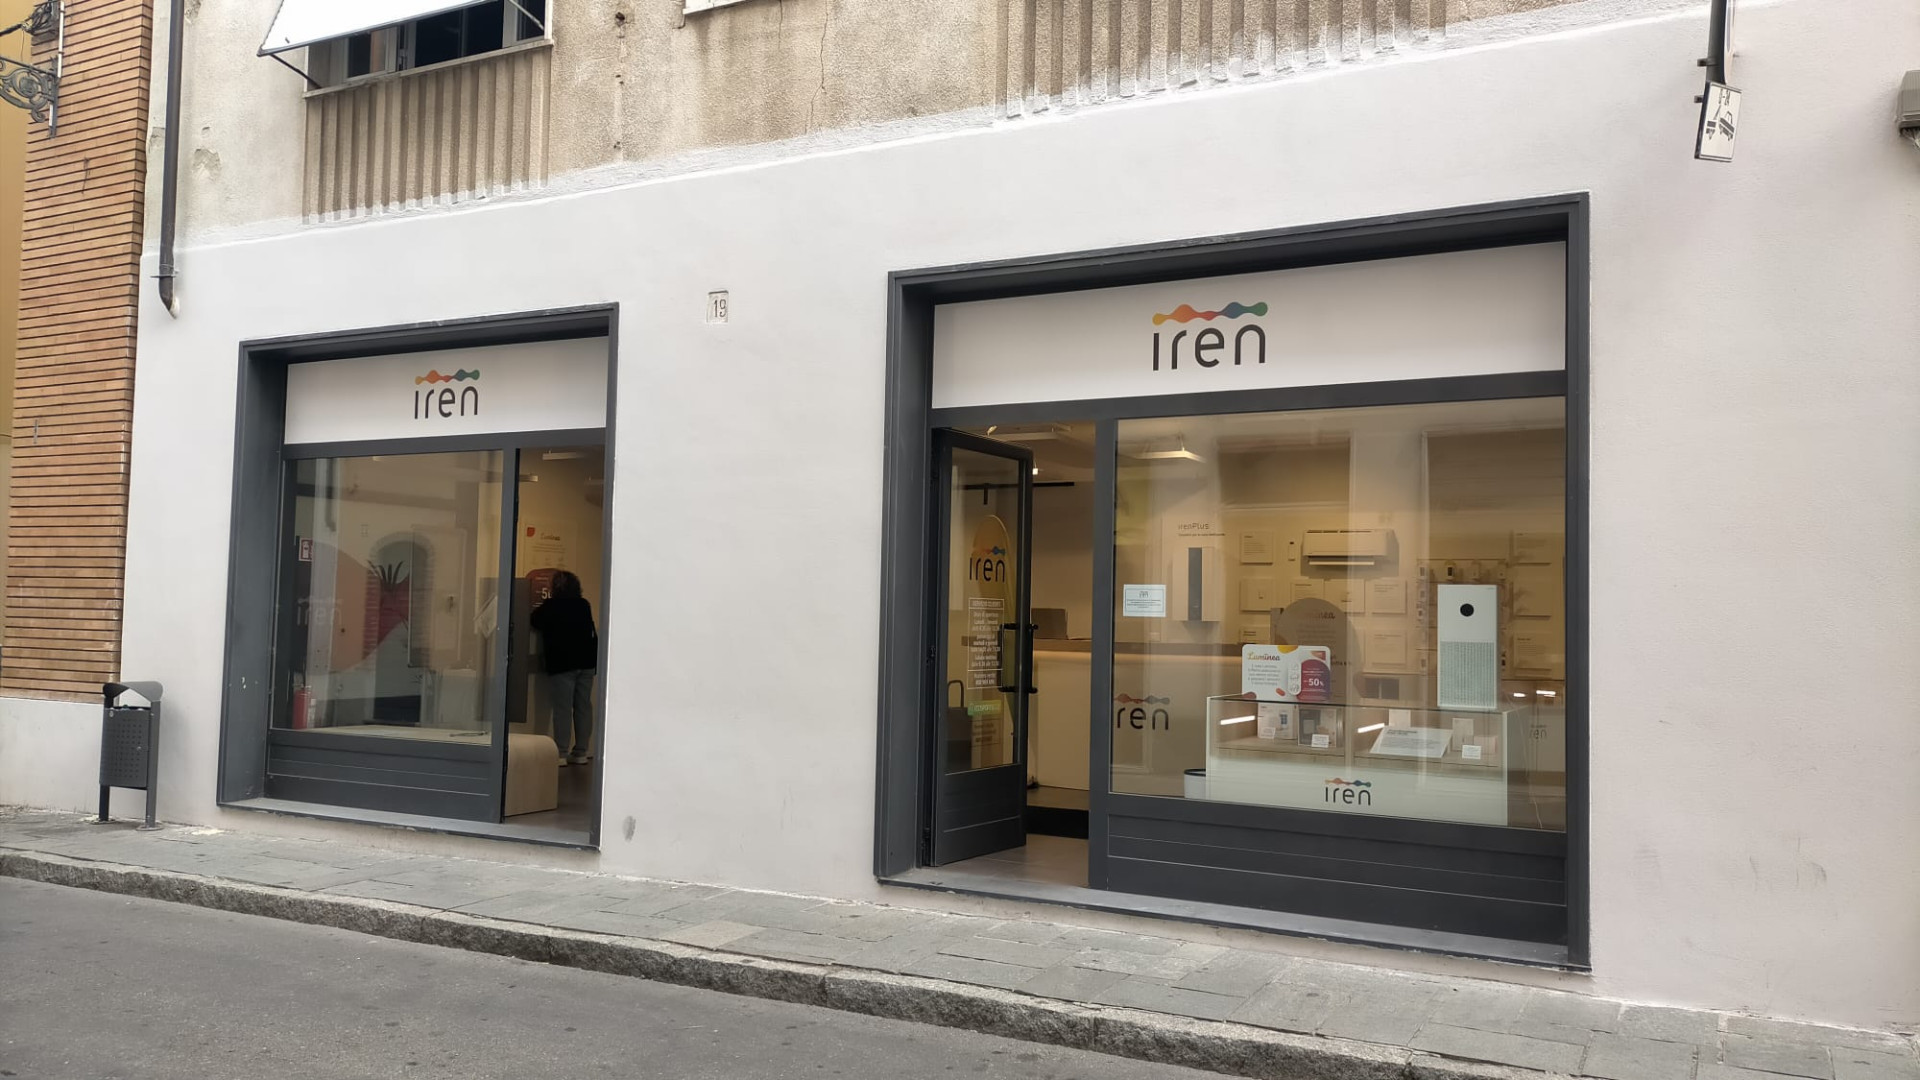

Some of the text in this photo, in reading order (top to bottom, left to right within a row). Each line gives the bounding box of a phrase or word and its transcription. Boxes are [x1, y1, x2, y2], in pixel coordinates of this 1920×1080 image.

[713, 298, 726, 317] 19
[1152, 324, 1266, 371] iren
[414, 386, 479, 419] iren
[969, 557, 1006, 583] iren
[1117, 707, 1169, 731] ren
[1325, 786, 1371, 806] iren
